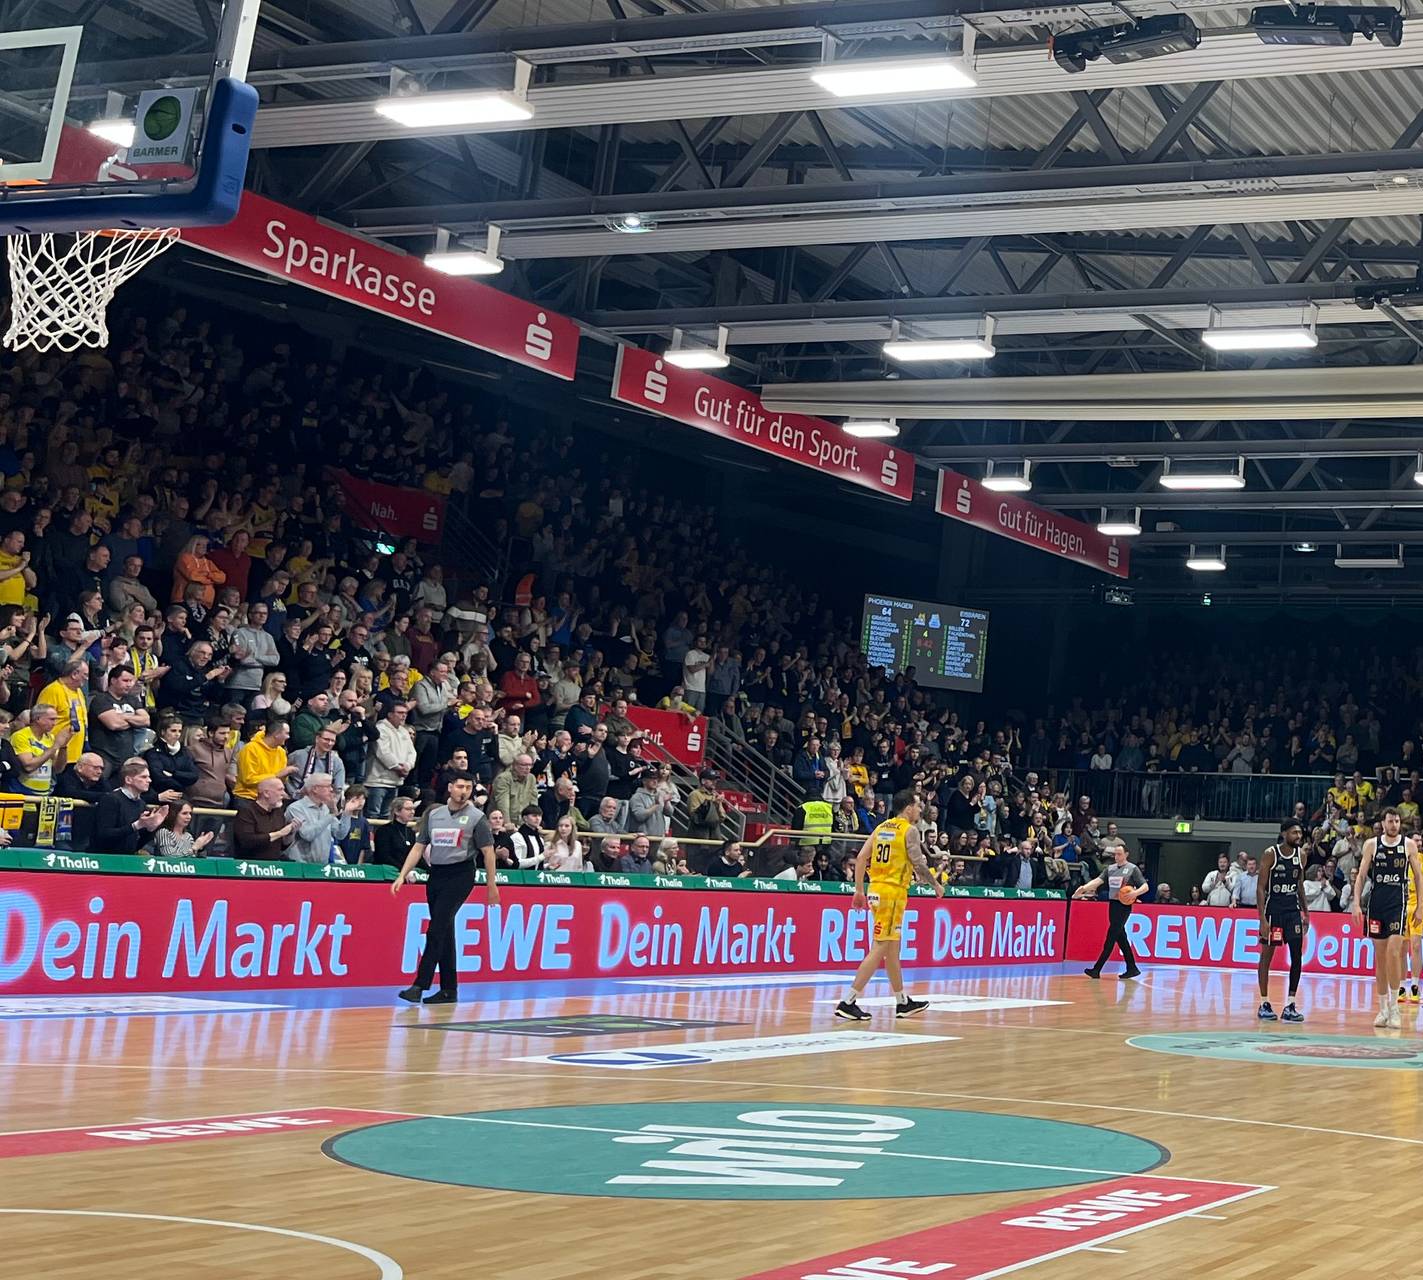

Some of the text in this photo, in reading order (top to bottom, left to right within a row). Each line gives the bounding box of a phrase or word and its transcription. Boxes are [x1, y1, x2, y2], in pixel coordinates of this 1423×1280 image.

[133, 146, 178, 157] BARMER
[263, 220, 436, 315] Sparkasse
[694, 386, 730, 426] Gut
[736, 400, 765, 436] für
[769, 415, 804, 452] den
[808, 430, 861, 472] Sport.
[371, 502, 397, 520] Nah.
[999, 503, 1022, 531] Gut
[1025, 511, 1043, 539] für
[1045, 520, 1086, 555] Hagen.
[882, 607, 892, 616] 64
[960, 619, 970, 628] 72
[876, 843, 891, 863] 30
[57, 855, 99, 870] Thalia
[158, 859, 195, 874] Thalia
[1393, 858, 1405, 868] 90
[249, 864, 284, 877] Thalia
[332, 866, 365, 879] Thalia
[480, 872, 509, 883] Talia
[546, 873, 571, 884] Thalia
[606, 875, 630, 886] Thalia
[661, 877, 682, 888] Thalia
[711, 879, 732, 889] Thalia
[1382, 874, 1400, 883] BLG
[758, 880, 778, 890] Thalia
[805, 882, 821, 892] Thalia
[920, 887, 936, 896] Thalia
[0, 889, 141, 982] Dein
[162, 898, 352, 978] Markt
[598, 902, 683, 969] Dein
[694, 906, 796, 965] Markt
[819, 908, 919, 962] REE
[932, 907, 984, 961] Dein
[990, 911, 1055, 958] Markt
[1123, 913, 1261, 965] REWE
[87, 1116, 333, 1142] REWE
[604, 1110, 916, 1187] wilo
[1001, 1189, 1192, 1232] REWE
